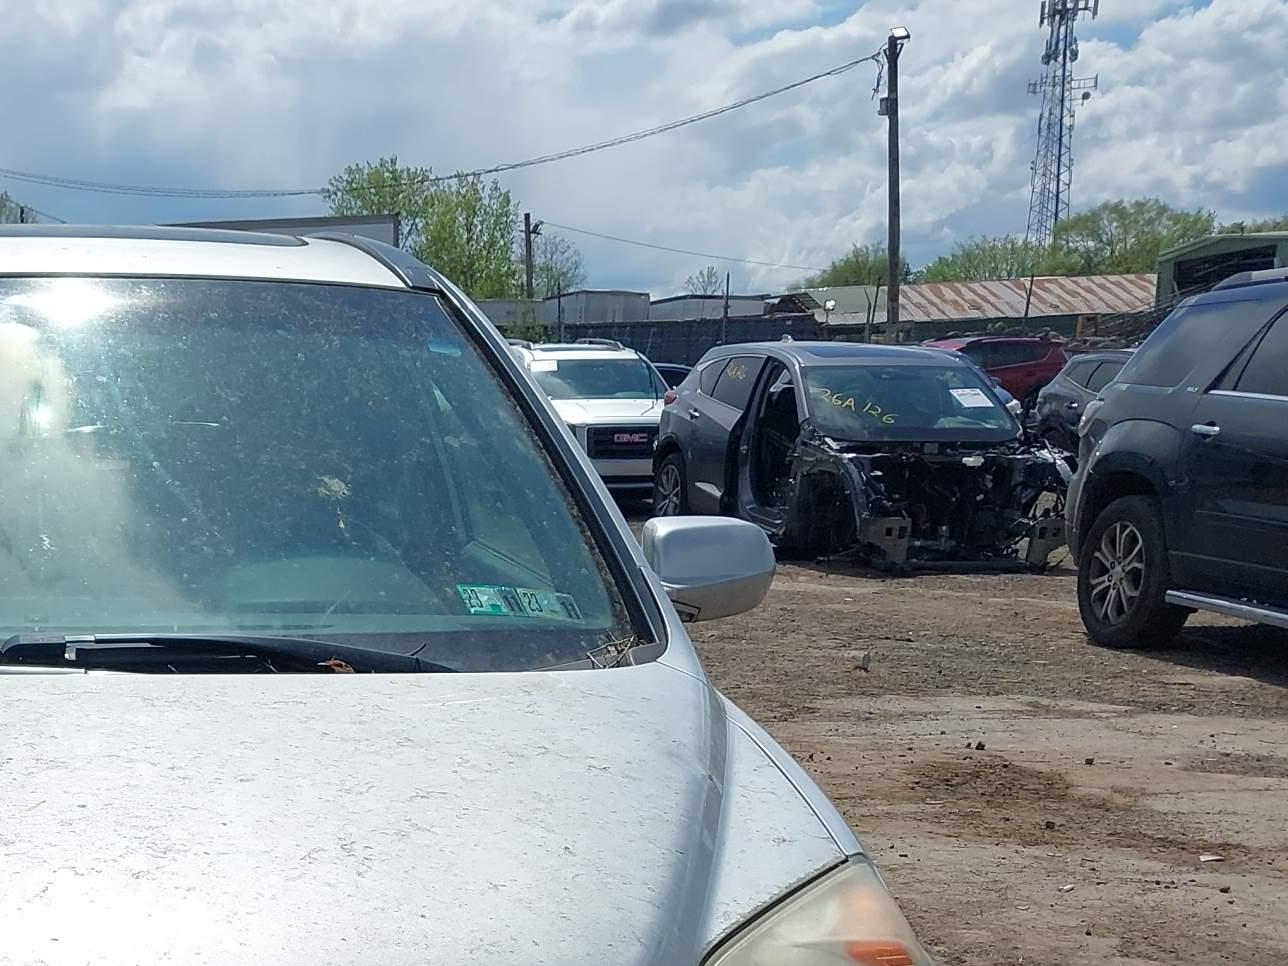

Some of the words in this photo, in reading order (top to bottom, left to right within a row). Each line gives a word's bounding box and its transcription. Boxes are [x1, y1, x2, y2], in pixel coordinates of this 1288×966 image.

[863, 401, 899, 424] 126
[614, 432, 648, 443] GMC
[463, 588, 484, 609] 23
[523, 592, 544, 613] 23
